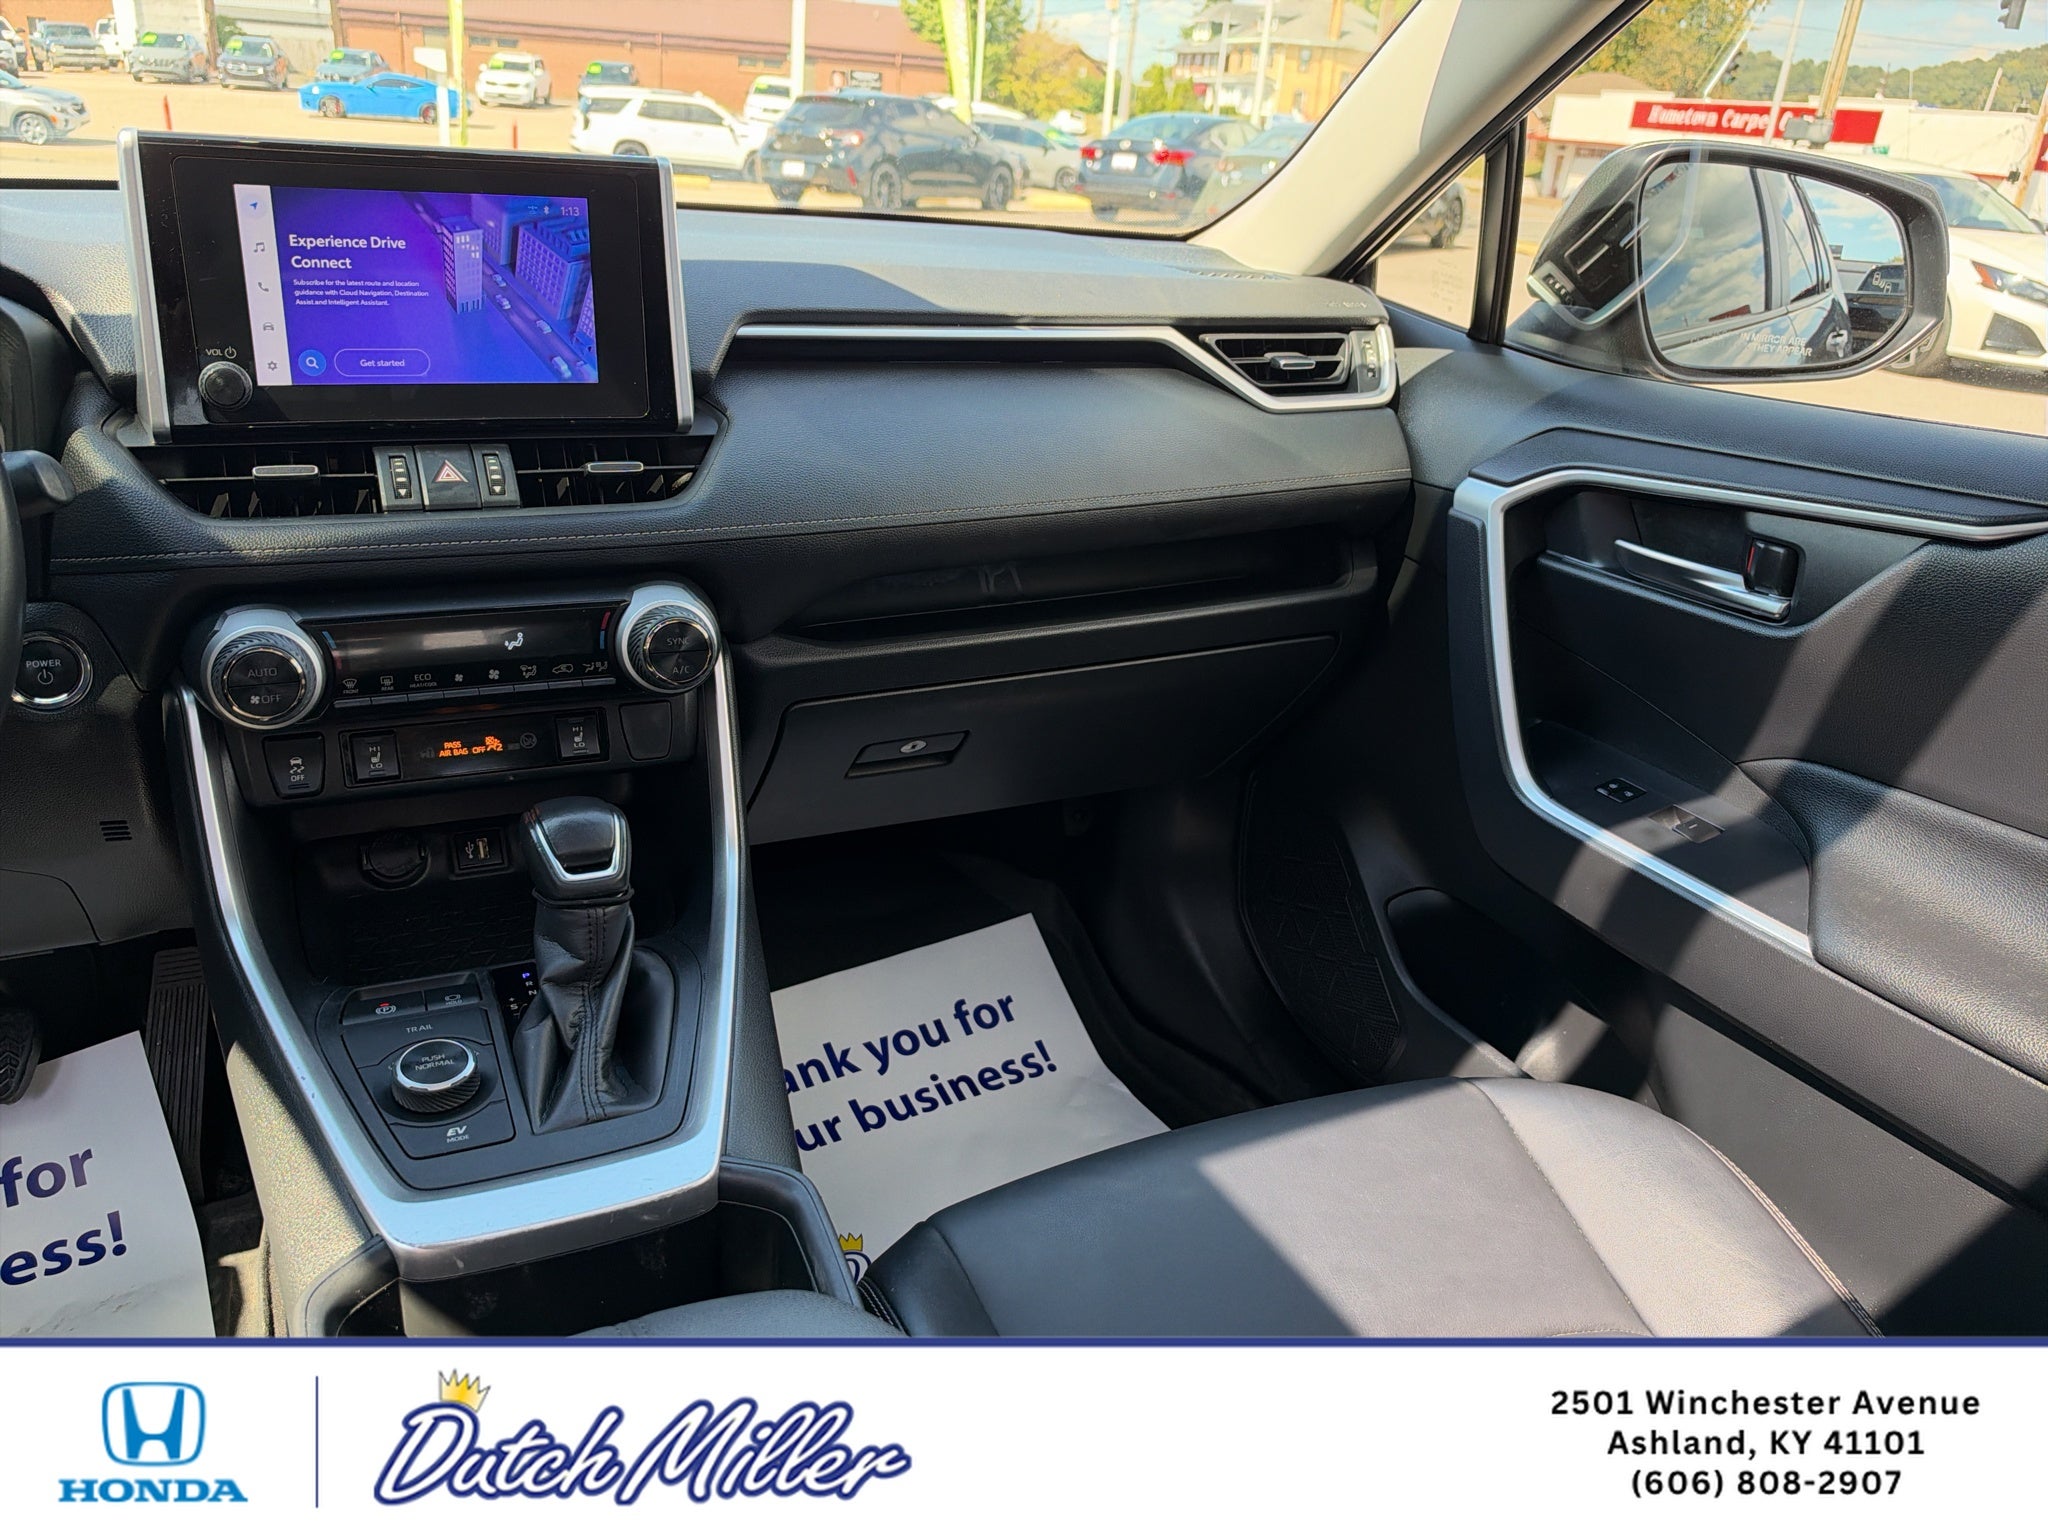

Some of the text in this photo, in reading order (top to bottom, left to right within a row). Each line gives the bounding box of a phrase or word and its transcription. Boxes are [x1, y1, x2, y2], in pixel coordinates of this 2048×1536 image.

[1647, 104, 1719, 128] Hometown
[1721, 107, 1772, 133] Carpe
[560, 206, 581, 217] 1:13
[288, 233, 407, 250] Experience Drive
[290, 255, 353, 269] Connect
[293, 279, 325, 287] Subscribe
[325, 279, 334, 287] for
[335, 279, 346, 287] the
[346, 279, 365, 287] latest
[382, 280, 395, 288] and
[395, 280, 420, 288] location
[294, 289, 324, 297] guidance
[324, 289, 339, 297] with
[339, 289, 359, 297] Cloud
[394, 290, 430, 298] Destination
[328, 299, 360, 308] Intelligent
[206, 348, 223, 357] VOL
[359, 359, 405, 368] Get started
[666, 636, 692, 647] SYNC
[25, 658, 62, 669] POWER
[247, 666, 278, 679] AUTO
[672, 665, 690, 675] A/C
[414, 673, 432, 681] ECO
[261, 693, 282, 704] OFF
[443, 740, 462, 749] PASS
[439, 745, 486, 758] AIR BAG OFF
[370, 761, 383, 769] LO
[290, 774, 305, 783] OFF
[405, 1023, 434, 1034] TRAIL
[783, 994, 1016, 1095] ank you for
[421, 1053, 446, 1063] PUSH
[414, 1059, 456, 1072] NORMAL
[794, 1039, 1058, 1152] ur business!
[446, 1125, 467, 1137] EV
[446, 1134, 470, 1144] MODE
[0, 1148, 93, 1208] for
[0, 1210, 127, 1286] ess!
